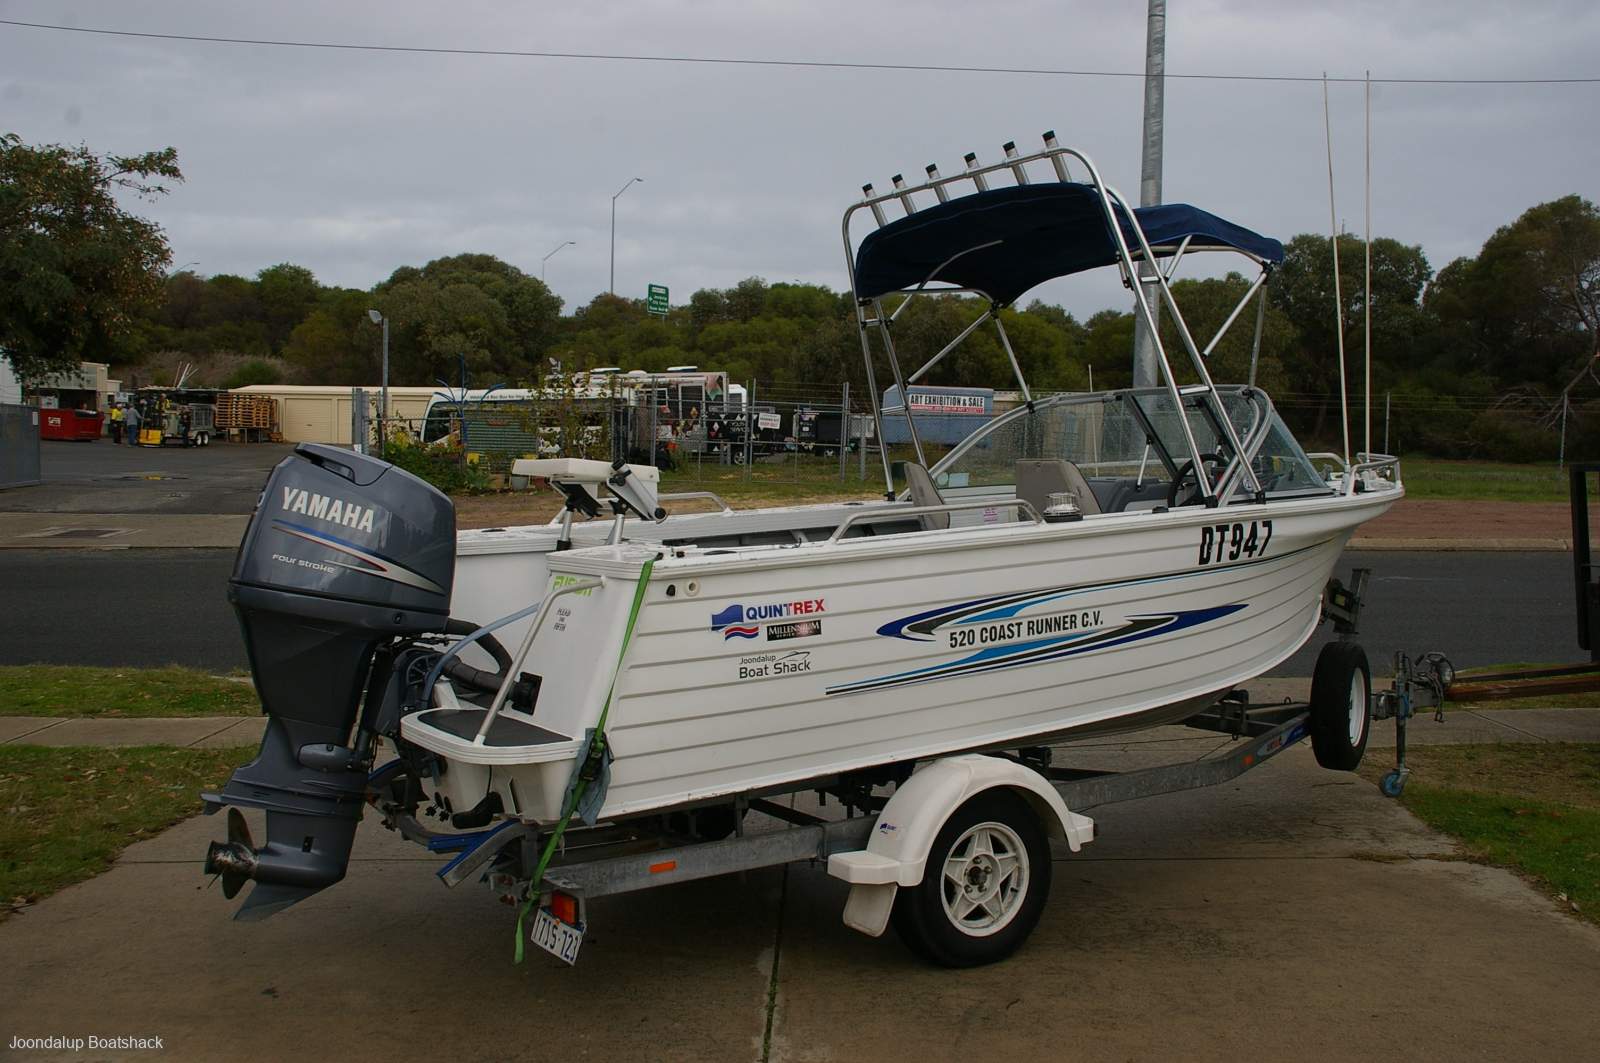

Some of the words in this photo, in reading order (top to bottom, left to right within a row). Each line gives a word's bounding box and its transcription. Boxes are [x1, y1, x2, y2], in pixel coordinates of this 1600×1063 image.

[910, 395, 923, 404] ART
[924, 395, 961, 406] EXHIBITION
[968, 397, 984, 407] SALE
[282, 486, 375, 533] YAMAHA
[1199, 520, 1272, 566] DT947
[745, 599, 825, 621] QUINTREX
[950, 629, 976, 649] 520
[980, 621, 1024, 644] COAST
[1027, 611, 1078, 637] RUNNER
[1081, 610, 1104, 629] C.V.
[739, 665, 769, 679] Boat
[773, 660, 811, 675] Shack
[740, 655, 777, 665] Joondalup
